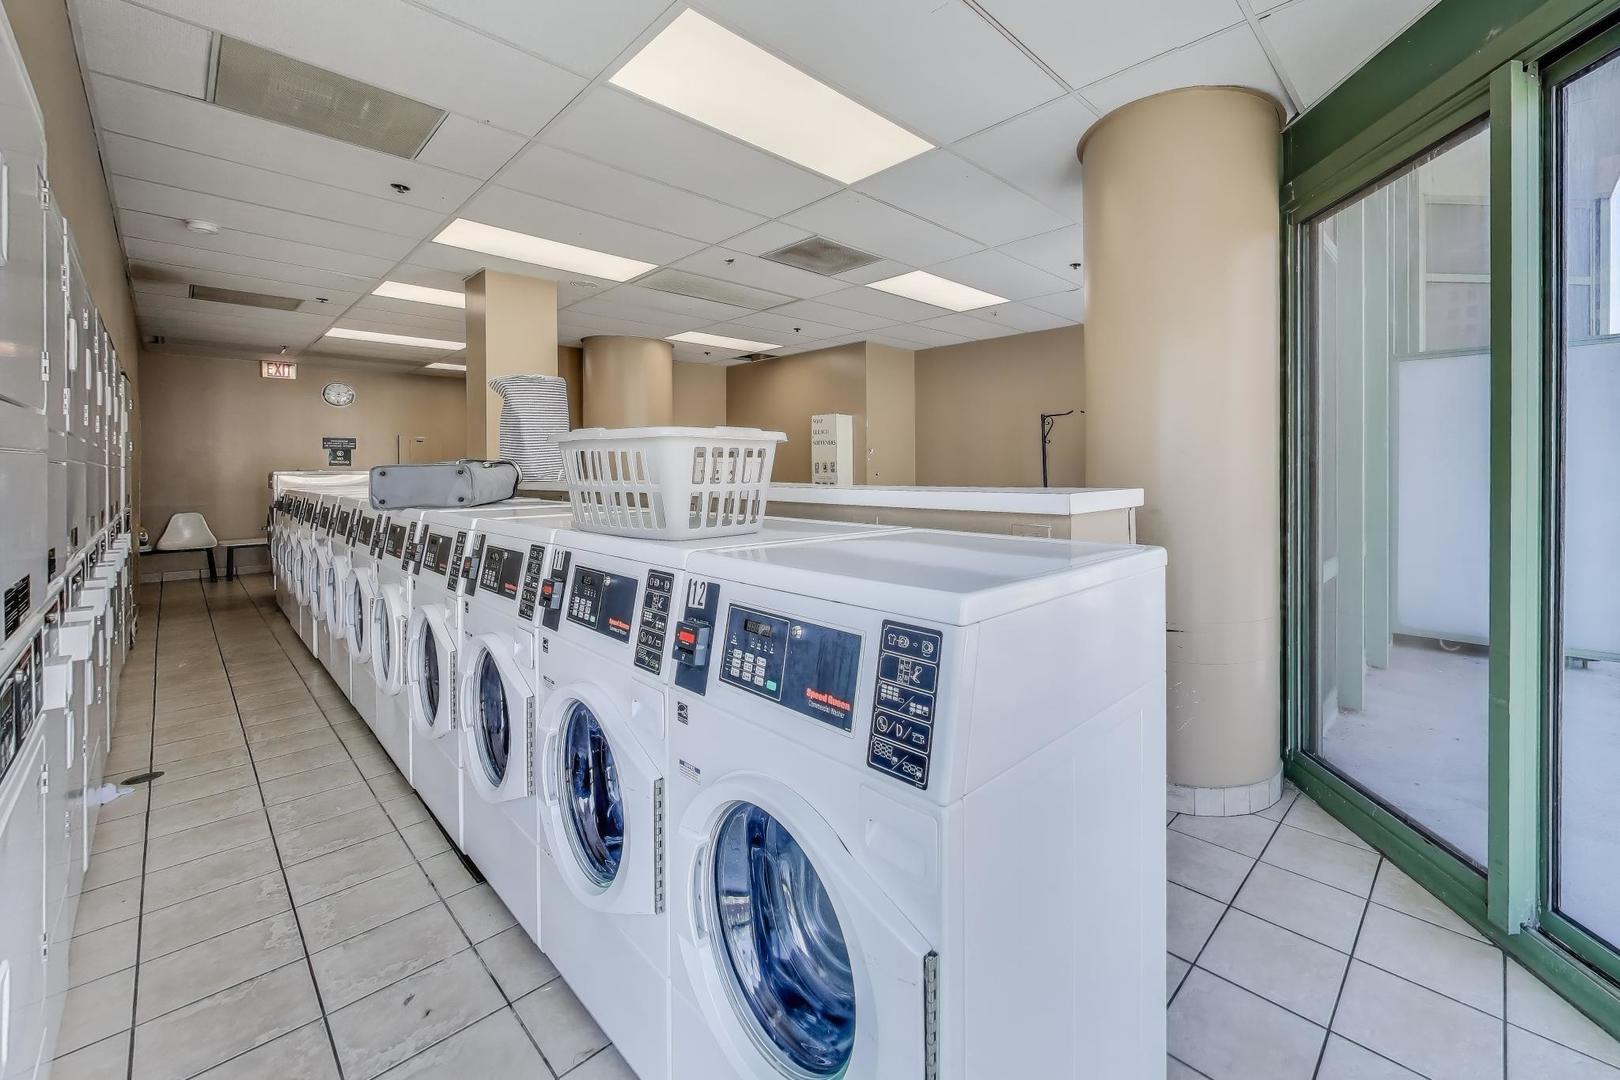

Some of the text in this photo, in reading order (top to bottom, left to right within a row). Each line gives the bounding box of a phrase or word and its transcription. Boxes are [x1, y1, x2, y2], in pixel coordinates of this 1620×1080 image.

[267, 363, 290, 377] EXIT
[806, 687, 851, 711] Speed Queen
